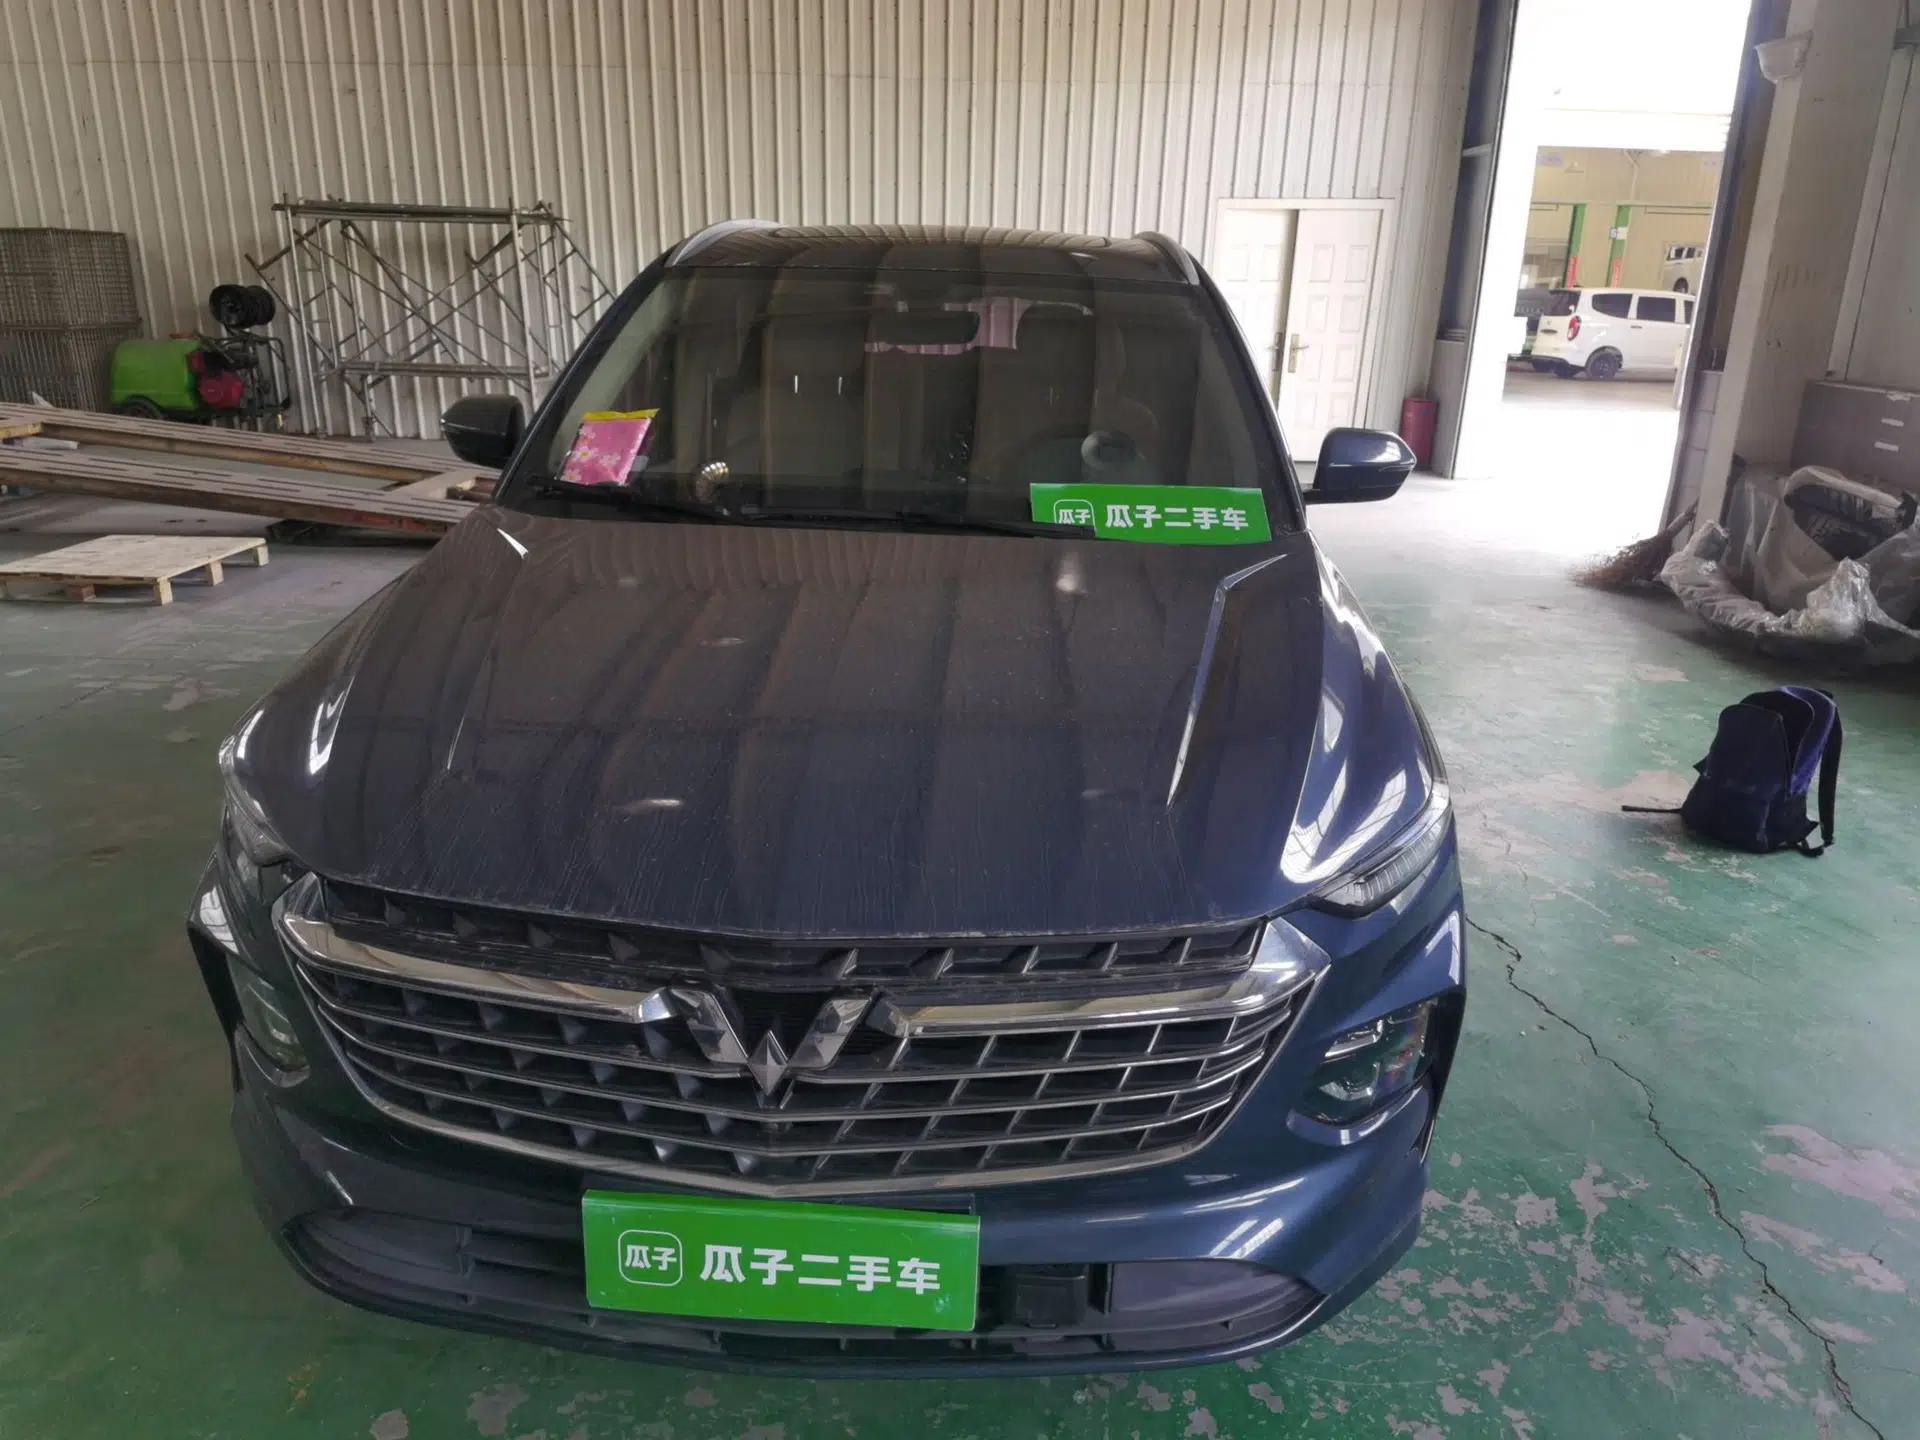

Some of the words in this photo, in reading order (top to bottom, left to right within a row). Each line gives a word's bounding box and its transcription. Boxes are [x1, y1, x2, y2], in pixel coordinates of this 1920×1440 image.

[1058, 508, 1091, 524] 瓜子
[1106, 504, 1249, 530] 瓜子二手车
[624, 1244, 678, 1271] 瓜子
[700, 1244, 940, 1295] 瓜子二手车
